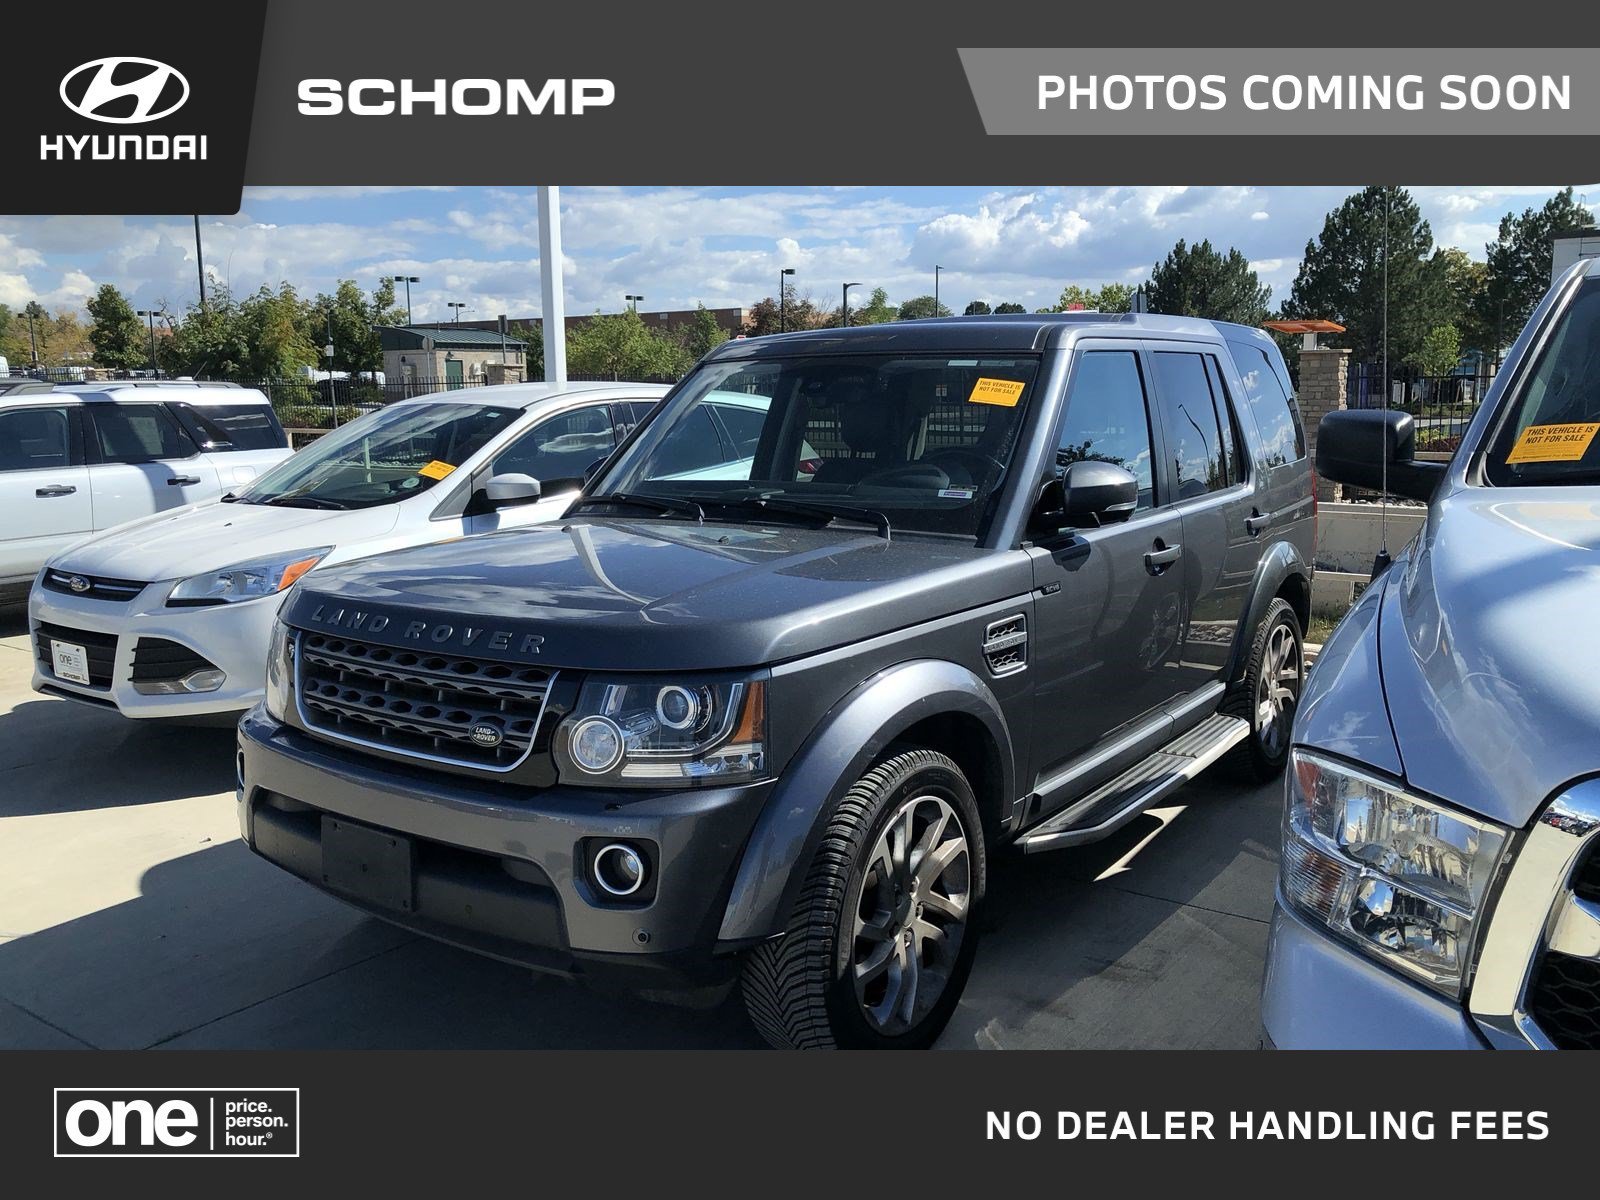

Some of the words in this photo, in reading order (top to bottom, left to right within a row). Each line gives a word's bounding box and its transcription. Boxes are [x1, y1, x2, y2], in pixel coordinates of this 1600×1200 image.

[1527, 428, 1547, 436] THIS
[1547, 426, 1585, 435] VEHICLE
[1585, 425, 1595, 433] IS
[1525, 436, 1543, 444] NOT
[1543, 435, 1562, 443] FOR
[1562, 434, 1586, 442] SALE
[310, 604, 390, 633] LAND
[403, 620, 546, 655] ROVER
[59, 653, 73, 666] one
[475, 727, 491, 735] LAND
[476, 734, 496, 742] ROVER
